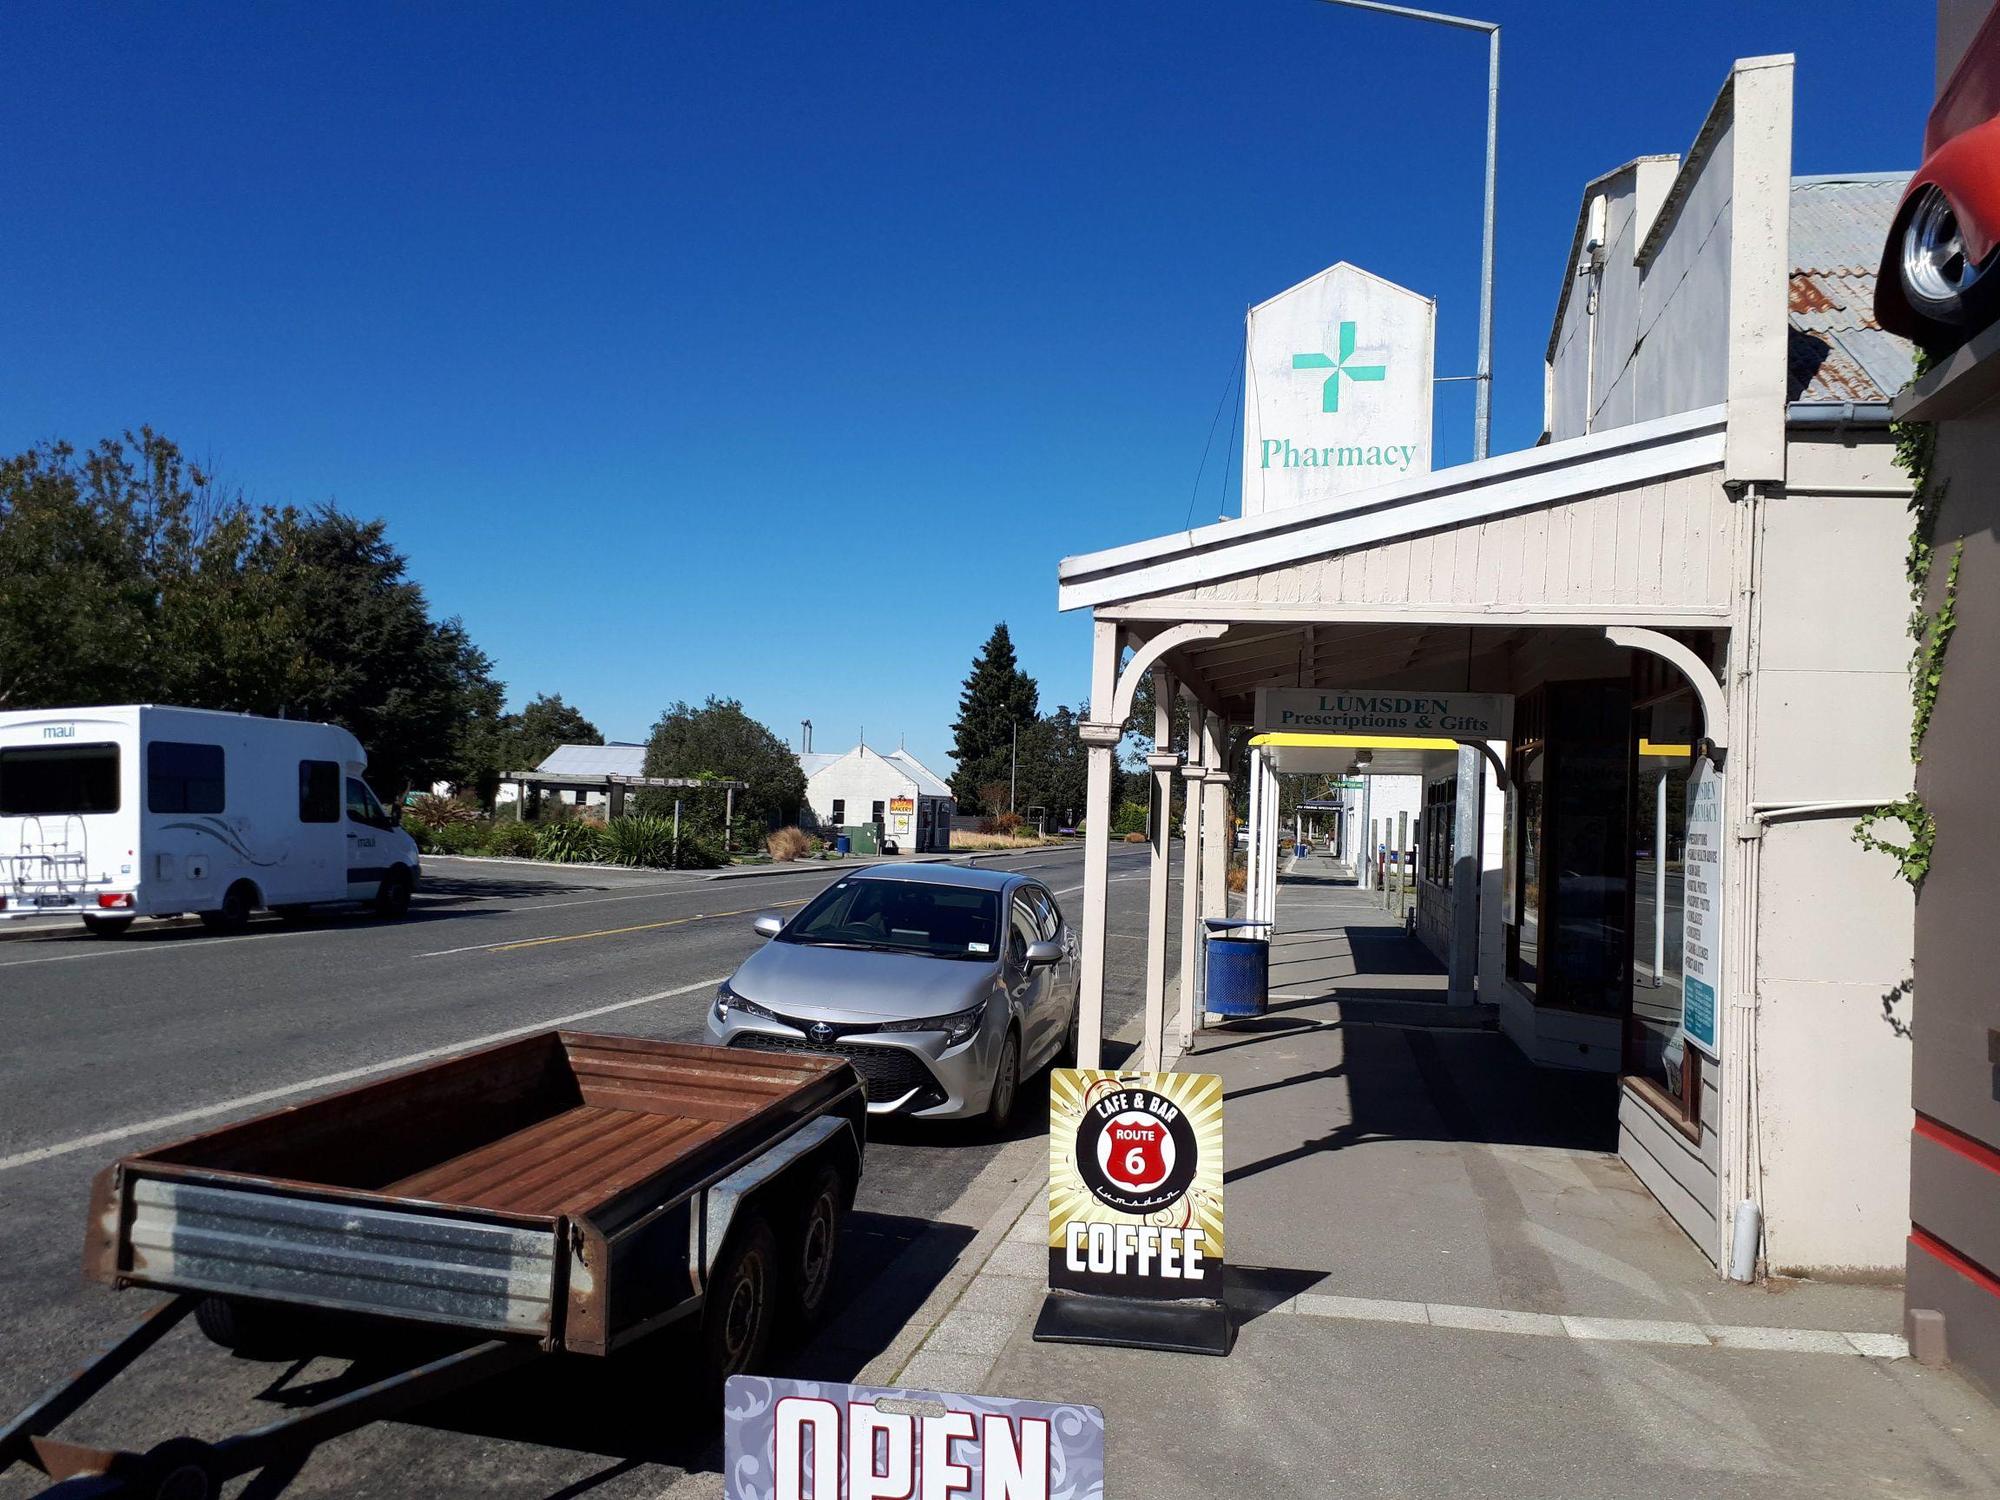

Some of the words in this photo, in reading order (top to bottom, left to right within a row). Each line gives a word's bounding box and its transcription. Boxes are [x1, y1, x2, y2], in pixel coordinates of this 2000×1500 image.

[1261, 439, 1416, 472] Pharmacy
[1319, 695, 1449, 715] LUMSDEN
[43, 722, 75, 738] maui
[1281, 710, 1407, 729] Prescriptions
[1414, 715, 1432, 728] &
[1439, 715, 1489, 731] Gifts
[357, 836, 376, 848] maui
[1096, 1094, 1128, 1119] CAFE
[1133, 1093, 1144, 1109] &
[1149, 1096, 1179, 1123] BAR
[1116, 1129, 1155, 1141] ROUTE
[1124, 1147, 1146, 1175] 6
[1066, 1221, 1206, 1280] COFFEE
[775, 1396, 1052, 1500] OPEN
